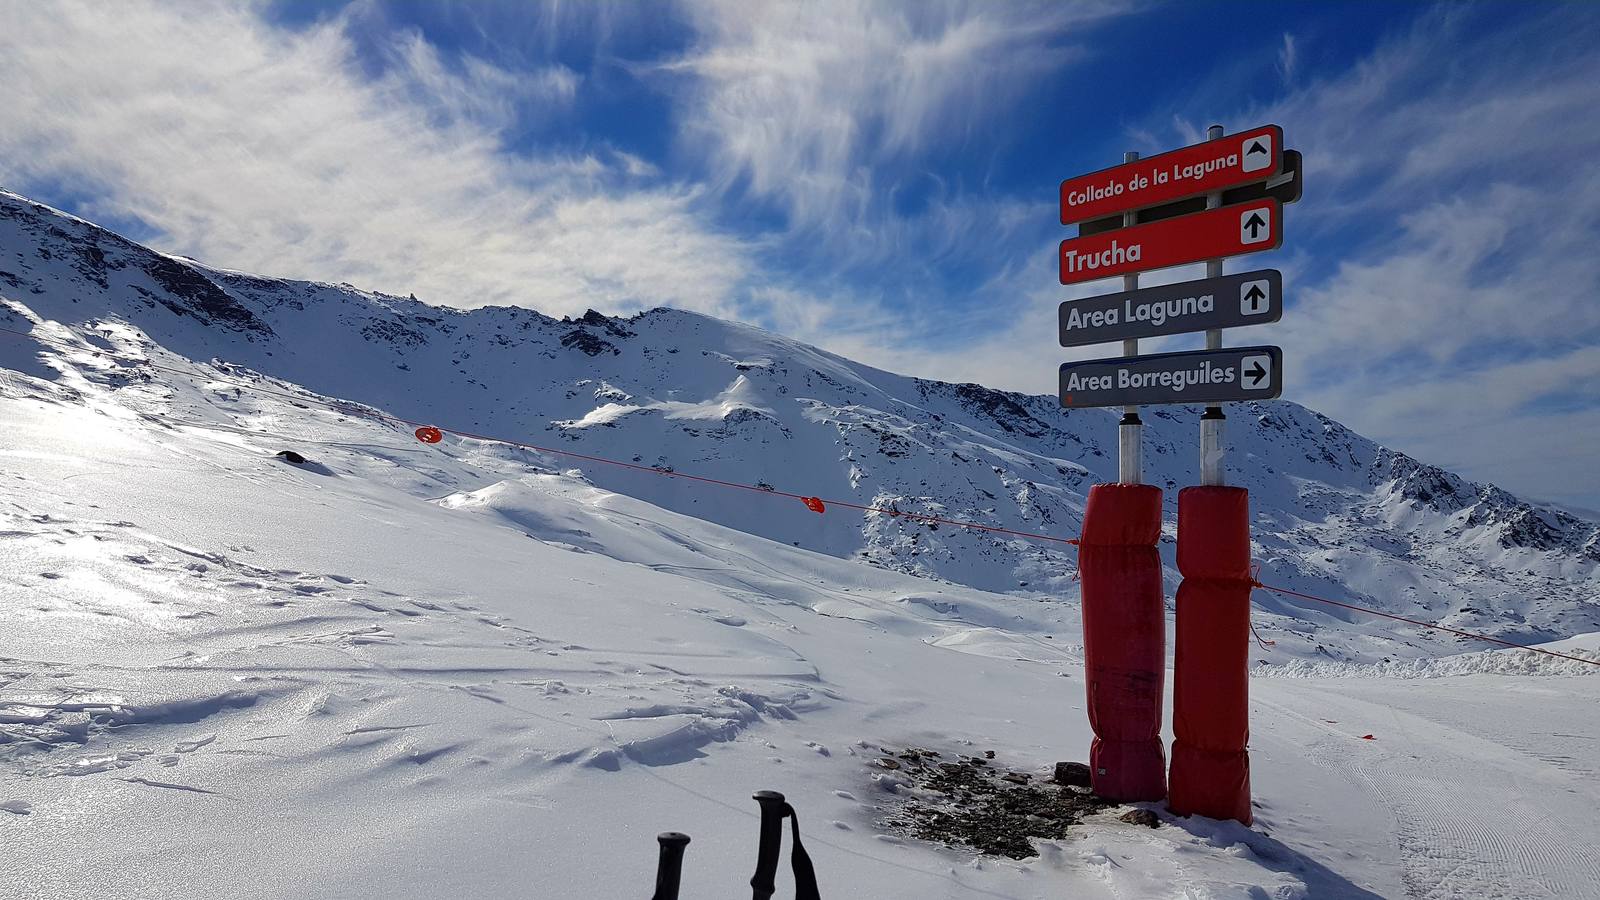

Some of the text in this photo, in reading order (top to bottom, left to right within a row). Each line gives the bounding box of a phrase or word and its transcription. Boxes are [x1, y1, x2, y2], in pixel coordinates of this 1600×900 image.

[1068, 153, 1238, 206] Collado de la Laguna
[1066, 240, 1141, 273] Trucha
[1066, 294, 1214, 331] Area Laguna
[1067, 361, 1235, 392] Area Borreguiles
